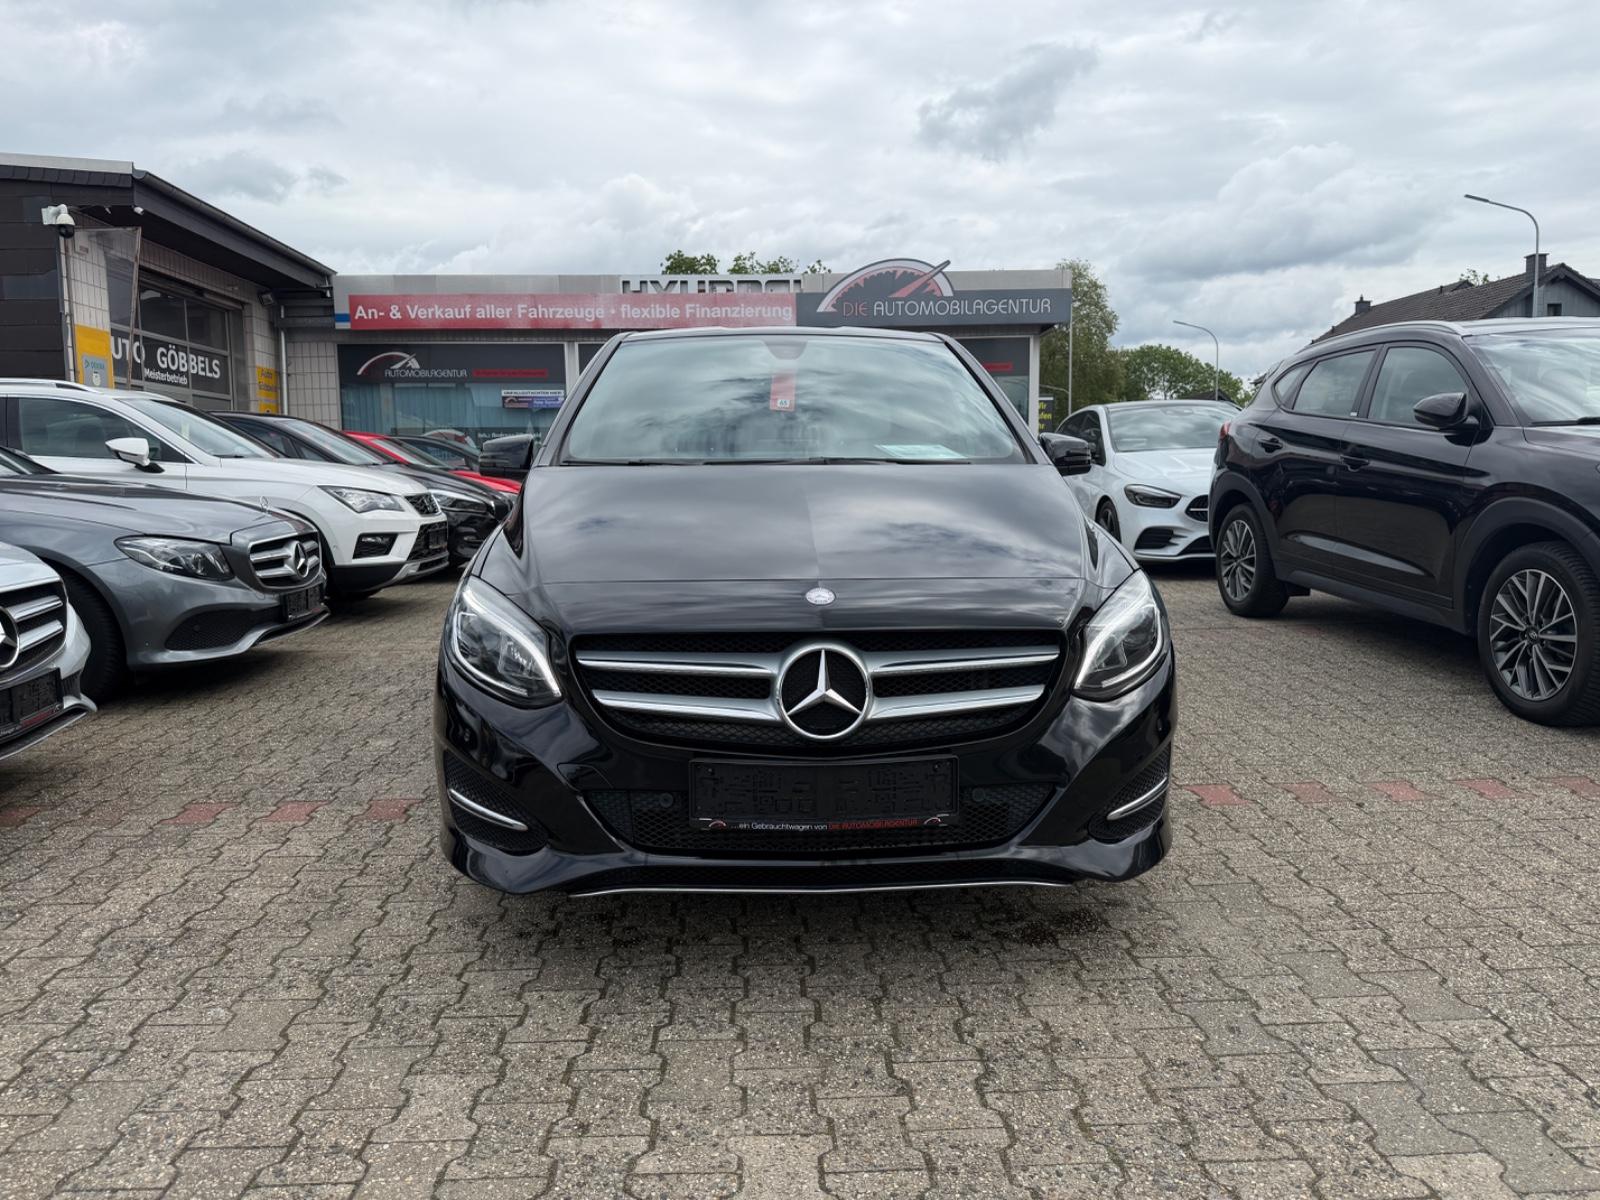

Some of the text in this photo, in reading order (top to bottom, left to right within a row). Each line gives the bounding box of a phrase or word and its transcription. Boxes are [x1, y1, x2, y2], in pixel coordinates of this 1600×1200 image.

[354, 303, 793, 322] An- & Verkauf aller Fahrzeuge flexible Finanzierung
[842, 298, 1051, 316] DIE AUTOMOBILAGENTUR
[111, 336, 220, 379] UTO GÖBBELS
[144, 368, 187, 385] Meisterbetrieb
[751, 822, 813, 831] Gebrauchtwagen
